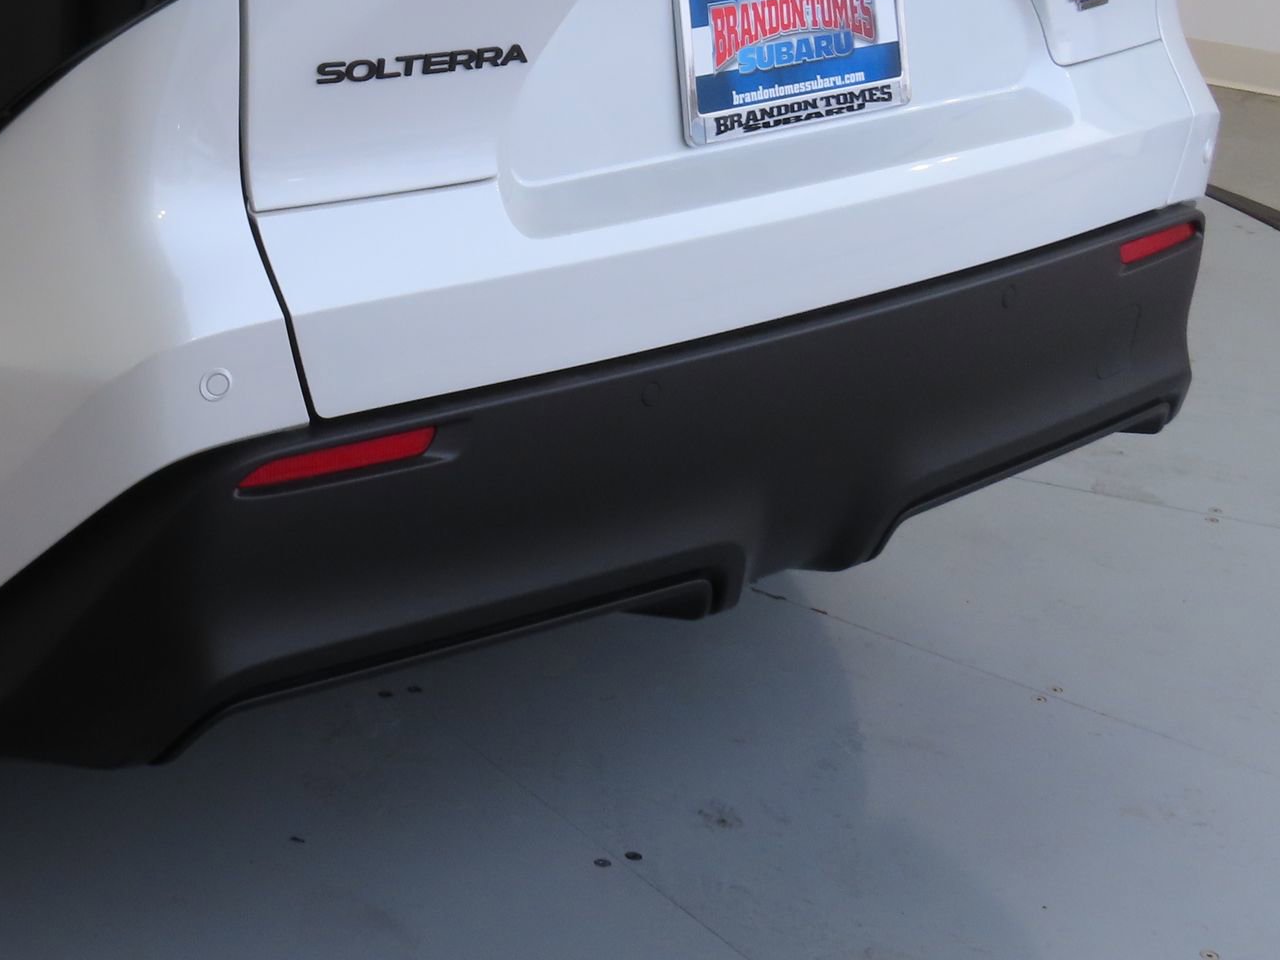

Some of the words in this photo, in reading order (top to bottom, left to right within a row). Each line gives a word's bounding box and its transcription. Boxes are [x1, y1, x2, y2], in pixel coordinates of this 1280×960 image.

[316, 44, 528, 84] SOLTERRA
[738, 31, 854, 73] SUBARU
[732, 72, 865, 105] brandontomessubaru.com
[714, 97, 818, 135] BRANDON
[821, 84, 892, 106] TOMES
[743, 102, 866, 133] SUBARU
